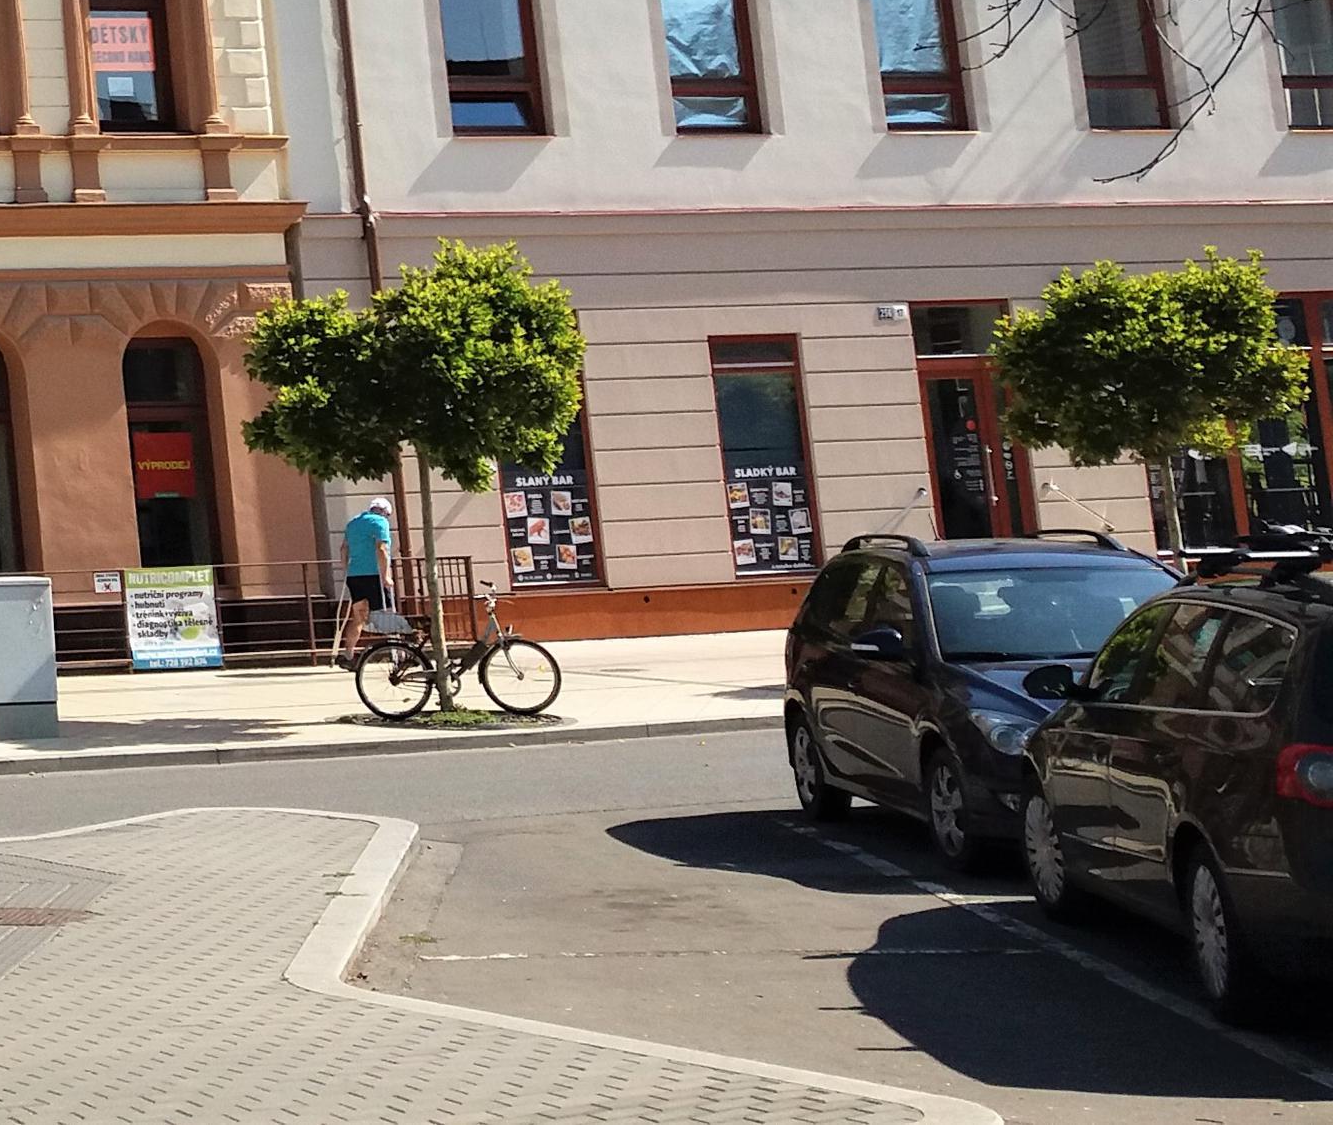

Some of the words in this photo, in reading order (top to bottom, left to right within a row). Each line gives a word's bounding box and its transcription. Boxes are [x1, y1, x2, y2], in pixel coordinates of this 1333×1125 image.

[90, 23, 149, 44] DĚTSKÝ
[136, 459, 191, 470] VÝPRODEJ
[734, 465, 774, 478] SLADKÝ
[775, 466, 797, 477] BAR
[515, 474, 550, 487] SLANÝ
[551, 475, 574, 486] BAR
[128, 569, 211, 584] NUTRICOMPLET
[134, 590, 164, 600] nutriční
[165, 590, 203, 600] programy
[134, 600, 166, 609] hubnutí
[136, 619, 183, 630] diagnostika
[183, 617, 214, 627] tělesné
[137, 630, 169, 639] skladby
